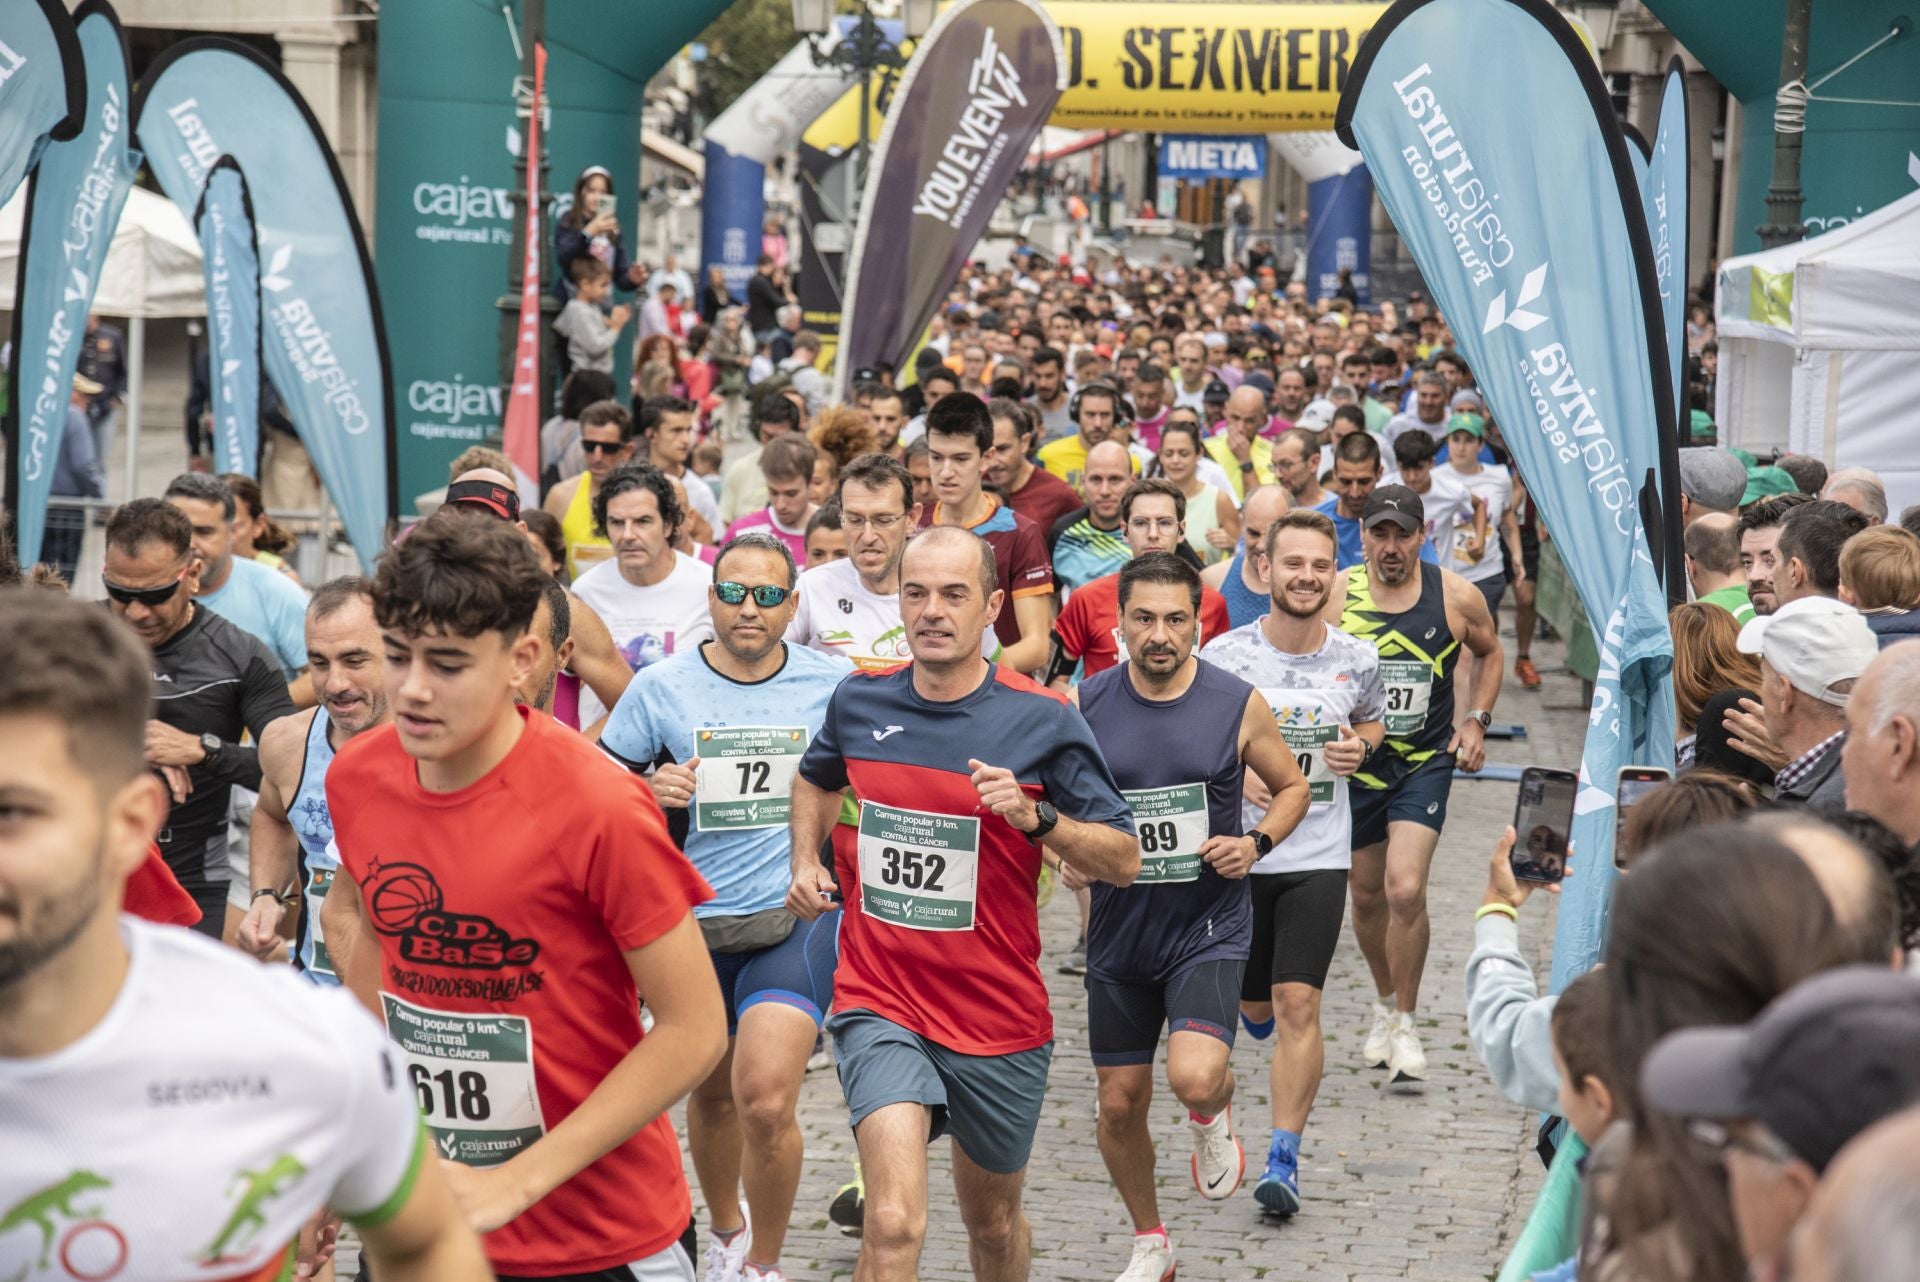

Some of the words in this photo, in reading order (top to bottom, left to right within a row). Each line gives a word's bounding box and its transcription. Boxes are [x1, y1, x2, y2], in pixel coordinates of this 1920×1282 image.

[1119, 26, 1369, 94] SEXMER
[1167, 141, 1258, 171] META
[711, 731, 740, 740] Carrera
[742, 730, 769, 740] popular
[733, 738, 772, 748] cajarural
[721, 748, 748, 756] CONTRA
[758, 746, 785, 754] CÁNCER
[736, 761, 770, 794] 72
[1143, 792, 1169, 803] popular
[1176, 789, 1190, 797] km.
[874, 808, 902, 822] Carrera
[903, 815, 934, 827] popular
[936, 818, 941, 828] 9
[943, 820, 958, 829] km.
[881, 830, 908, 843] CONTRA
[909, 836, 918, 844] EL
[919, 837, 948, 847] CÁNCER
[894, 823, 934, 837] cajarural
[1139, 821, 1178, 853] 89
[881, 847, 946, 892] 352
[870, 895, 900, 910] cajaviva
[914, 904, 957, 917] cajarural
[418, 915, 499, 940] C.D.
[396, 1005, 421, 1026] Carrera
[423, 1017, 464, 1033] popular
[466, 1021, 475, 1034] 9
[477, 1022, 500, 1035] km.
[413, 1029, 468, 1047] cajarural
[435, 1047, 447, 1057] EL
[449, 1047, 490, 1060] CÁNCER
[147, 1076, 273, 1106] SEGOVIA
[406, 1063, 491, 1122] 618
[459, 1136, 522, 1152] cajarural
